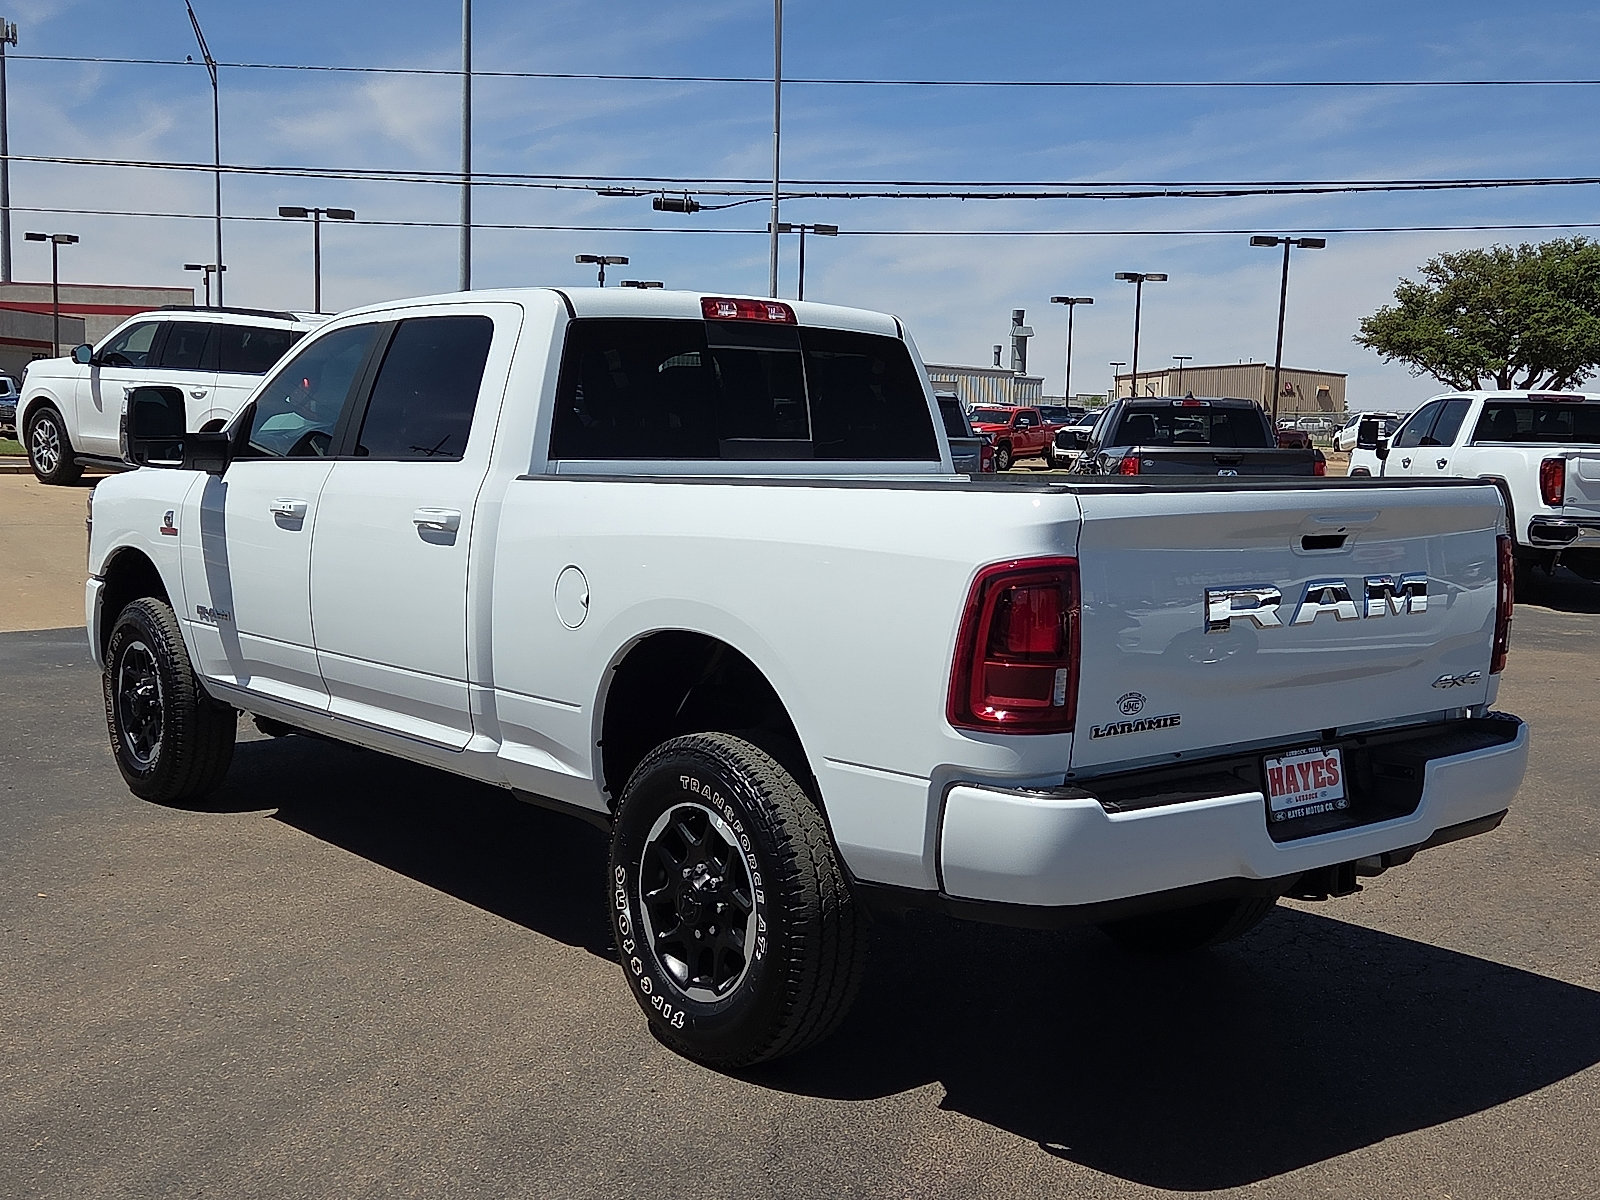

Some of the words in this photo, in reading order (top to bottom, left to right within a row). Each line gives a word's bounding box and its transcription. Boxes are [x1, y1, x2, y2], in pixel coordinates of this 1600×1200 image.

[1204, 572, 1428, 634] RAM
[1090, 713, 1181, 739] LARAMIE
[1268, 757, 1340, 797] HAYES
[1287, 808, 1304, 819] HAYES
[1305, 804, 1324, 815] MOTOR
[680, 775, 766, 905] TRANSFORCE
